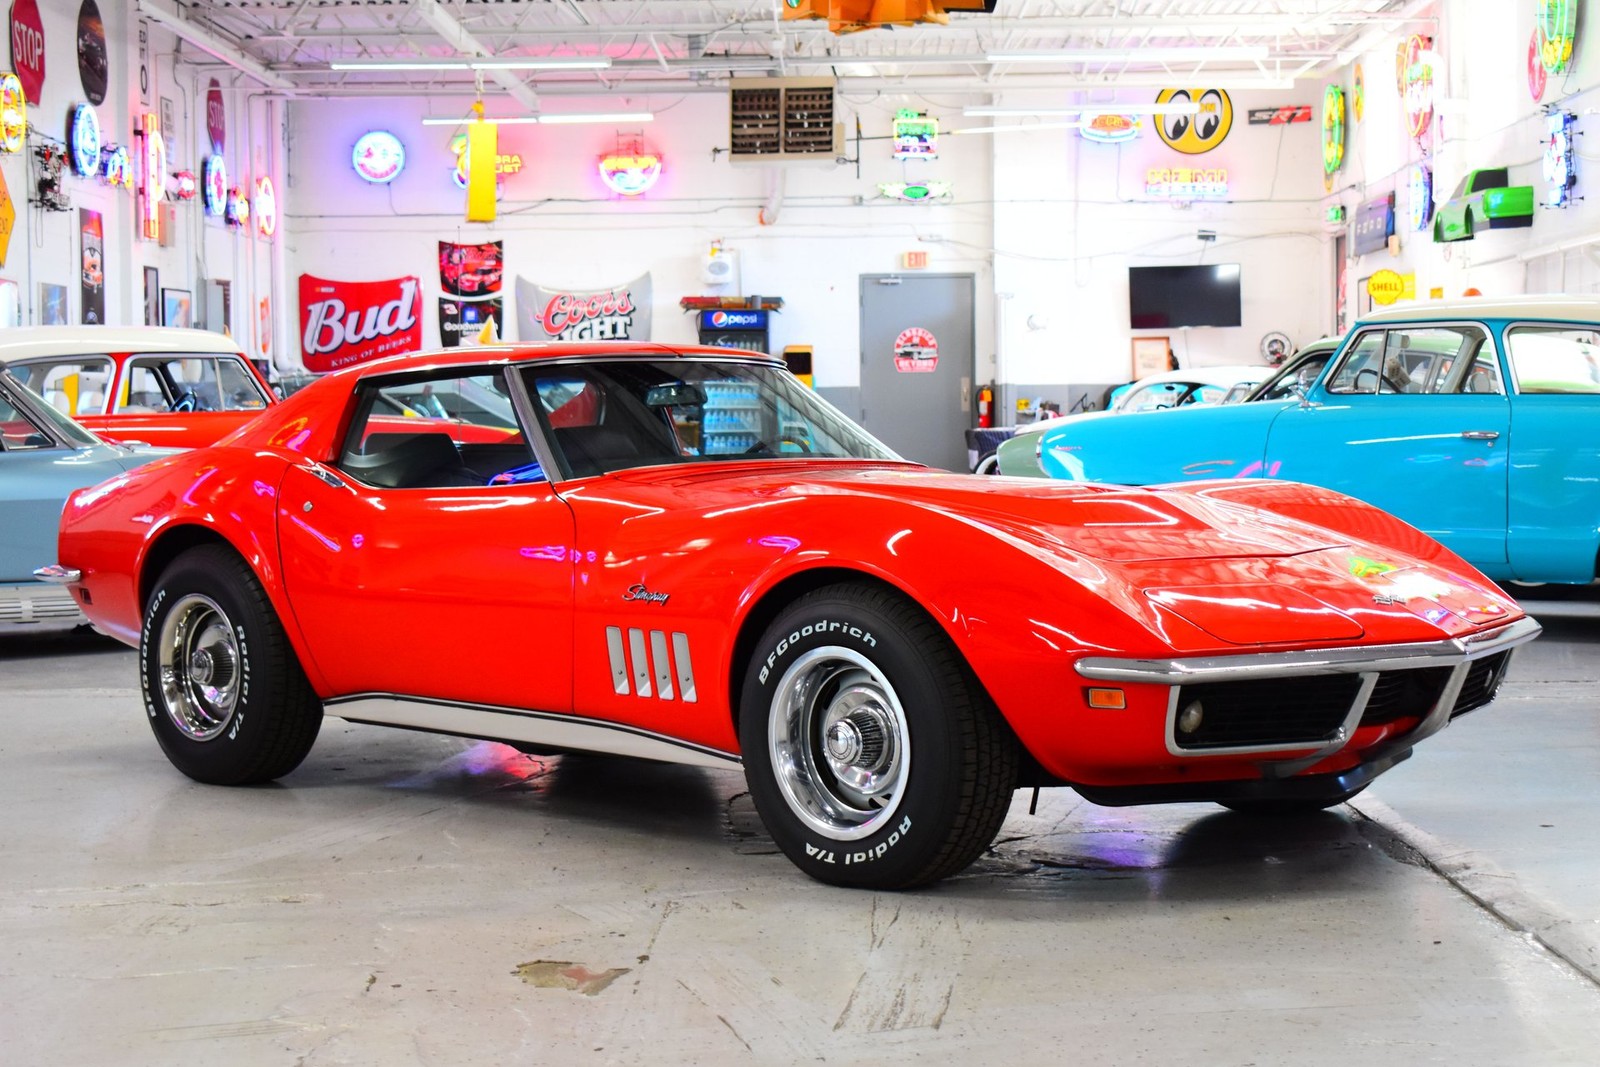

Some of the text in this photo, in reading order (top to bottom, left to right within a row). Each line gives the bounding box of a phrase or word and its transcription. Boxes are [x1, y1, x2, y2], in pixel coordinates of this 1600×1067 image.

[14, 20, 43, 71] STOP
[208, 100, 225, 131] STOP
[1250, 107, 1312, 122] SRT
[495, 154, 521, 164] BRA
[908, 252, 926, 268] EXIT
[1372, 283, 1399, 291] SHELL
[303, 280, 416, 355] Bud
[444, 303, 458, 315] 3
[535, 290, 634, 336] Coors
[728, 314, 758, 326] pepsi
[555, 316, 631, 340] IGHT
[331, 336, 412, 367] KING OF BEERS
[622, 583, 670, 607] Stingray
[758, 619, 878, 686] BFGoodrich
[229, 625, 250, 740] Radial T/A
[805, 814, 912, 865] Radial T/A
